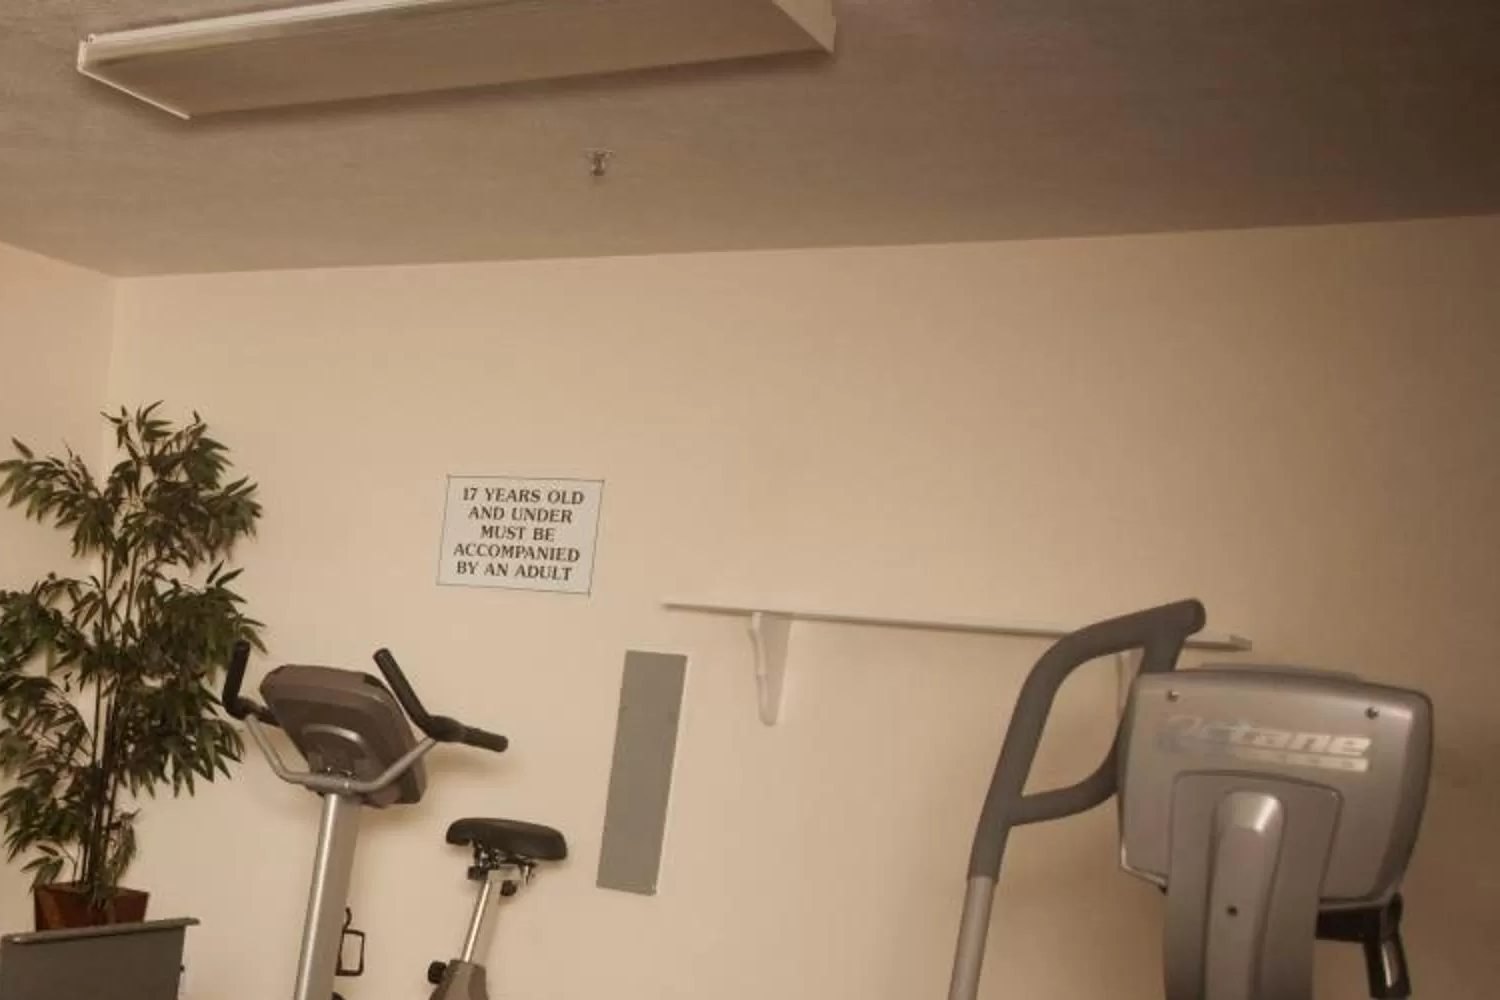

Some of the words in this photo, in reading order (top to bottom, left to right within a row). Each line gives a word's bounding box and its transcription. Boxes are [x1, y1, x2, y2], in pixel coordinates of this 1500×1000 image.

[462, 487, 478, 501] 17
[485, 488, 542, 503] YEARS
[547, 490, 585, 505] OLD
[468, 507, 505, 521] AND
[512, 508, 573, 524] UNDER
[480, 525, 527, 541] MUST
[533, 527, 556, 542] BE
[453, 543, 581, 563] ACCOMPANIED
[457, 561, 479, 576] BY
[484, 563, 509, 577] AN
[514, 565, 573, 581] ADULT
